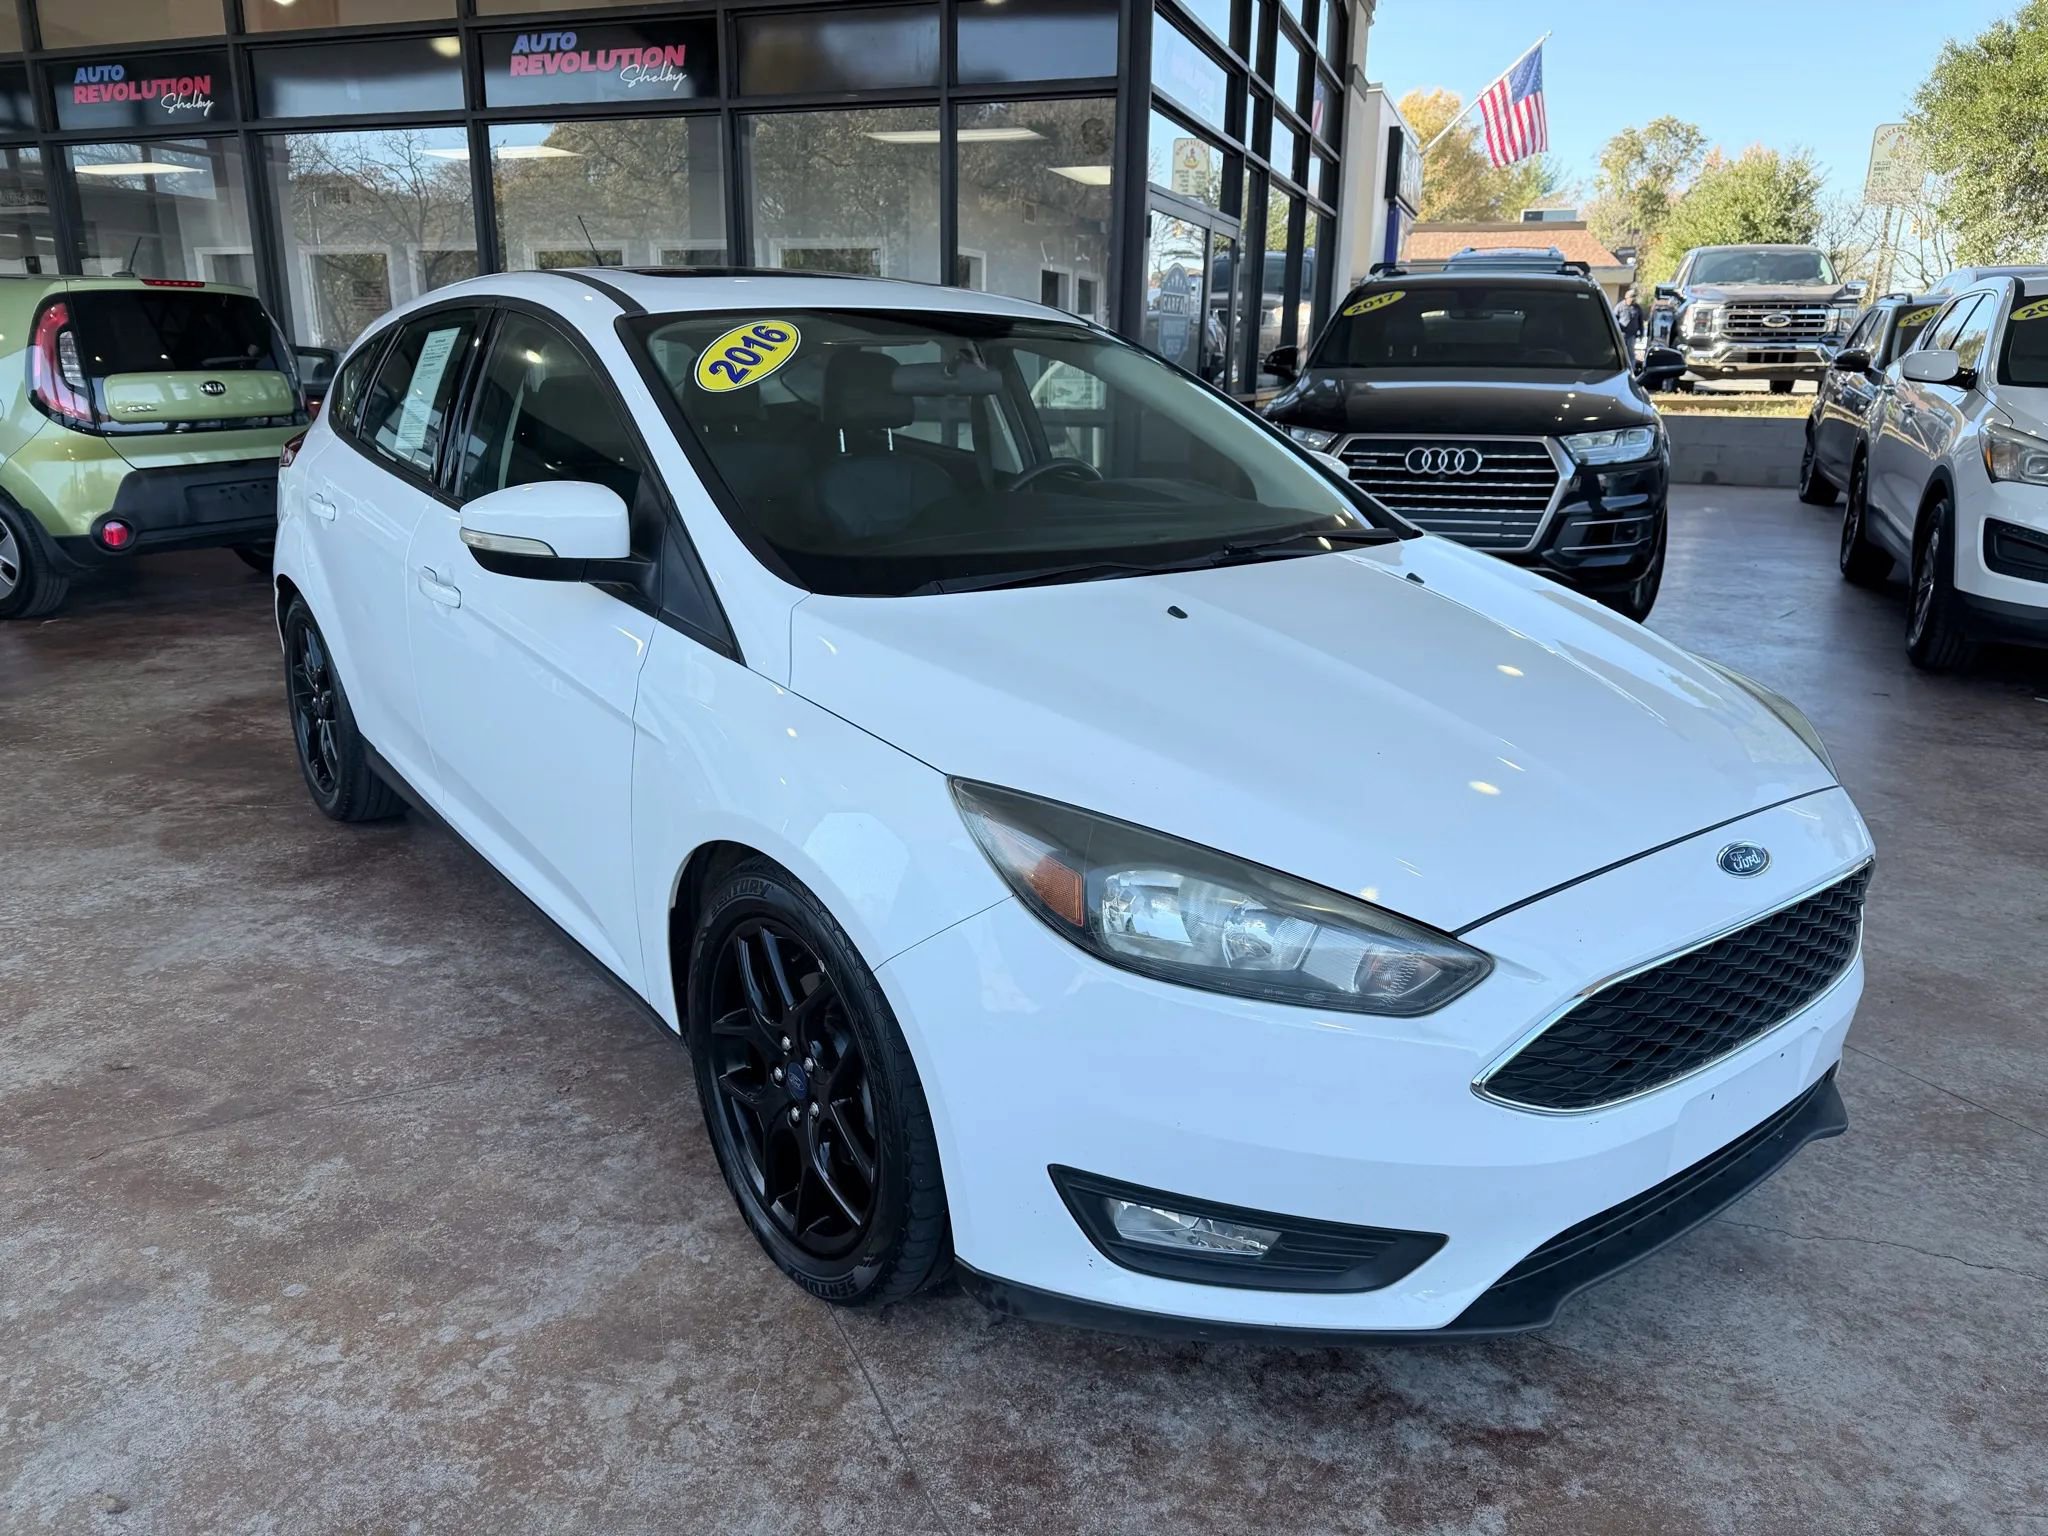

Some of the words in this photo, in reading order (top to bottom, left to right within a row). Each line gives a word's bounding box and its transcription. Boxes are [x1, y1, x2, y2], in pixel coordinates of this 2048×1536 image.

[512, 31, 577, 54] AUTO
[510, 44, 686, 77] REVOLUTION
[74, 64, 125, 84] AUTO
[619, 60, 687, 91] Shelby
[74, 74, 212, 104] REVOLUTION
[160, 90, 214, 117] Shelby
[1351, 292, 1396, 314] 2017
[1904, 307, 1937, 325] 2017
[708, 325, 791, 384] 2016
[1728, 848, 1761, 872] Ford
